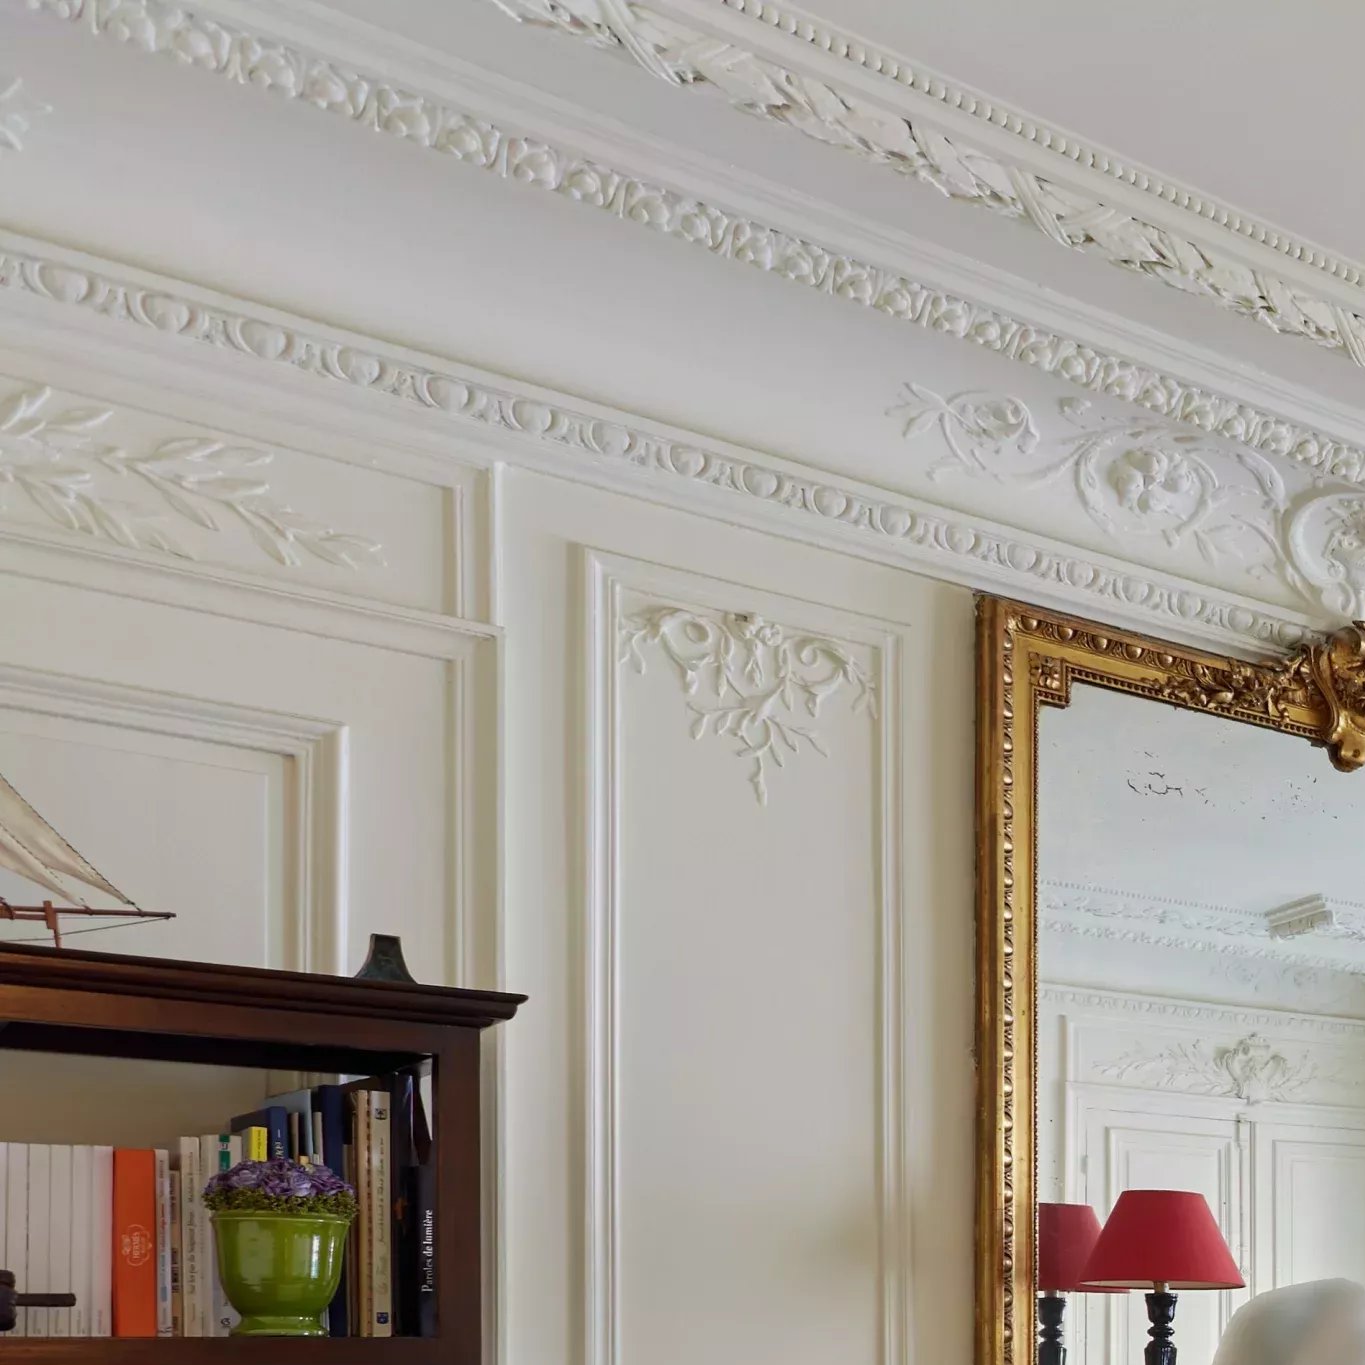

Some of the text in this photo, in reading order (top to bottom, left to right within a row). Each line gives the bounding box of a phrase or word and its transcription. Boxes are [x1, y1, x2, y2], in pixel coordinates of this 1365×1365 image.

[421, 1210, 433, 1292] Paroles de lumière
